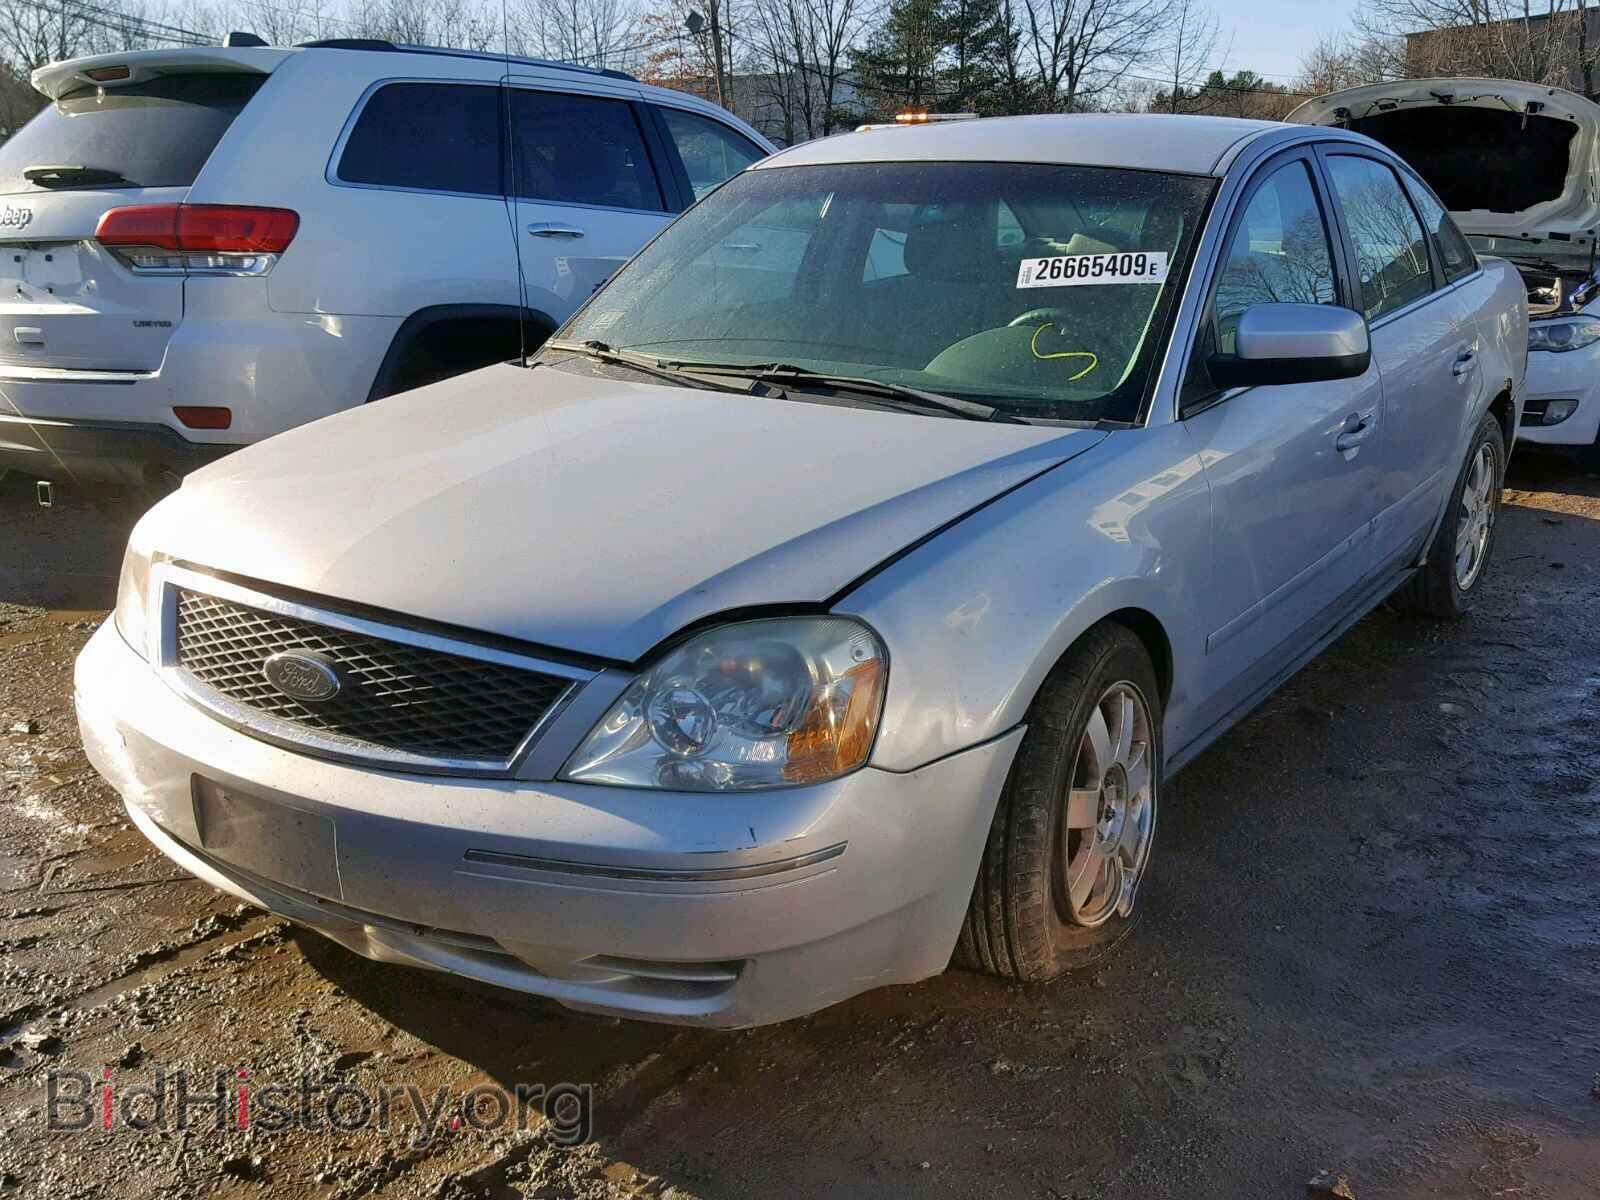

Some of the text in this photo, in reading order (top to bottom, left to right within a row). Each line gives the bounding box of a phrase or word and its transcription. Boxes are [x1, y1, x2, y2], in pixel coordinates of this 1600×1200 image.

[1035, 254, 1147, 280] 26665409
[1150, 263, 1158, 276] E
[279, 661, 320, 693] Ford
